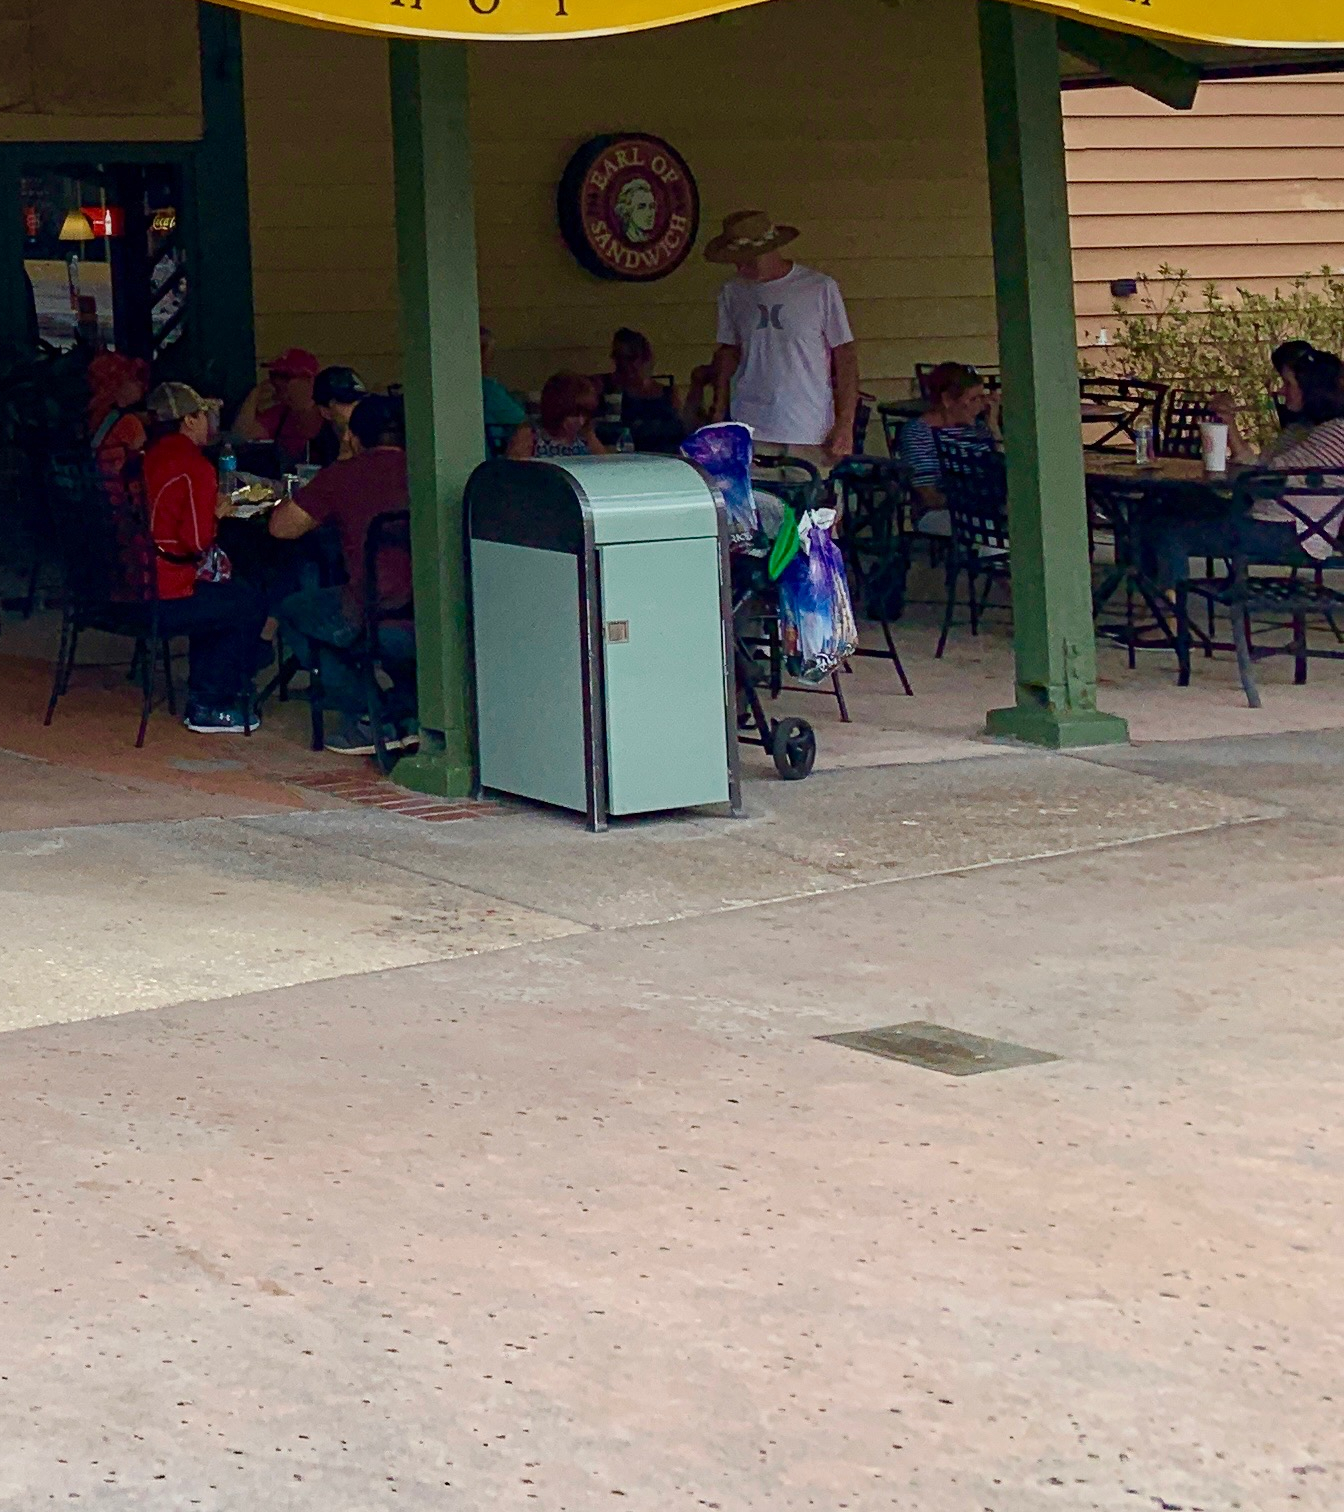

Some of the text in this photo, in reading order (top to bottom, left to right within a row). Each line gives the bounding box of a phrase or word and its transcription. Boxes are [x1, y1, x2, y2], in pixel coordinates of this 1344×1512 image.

[589, 147, 680, 190] EARL OF
[590, 213, 689, 269] SANDWICH
